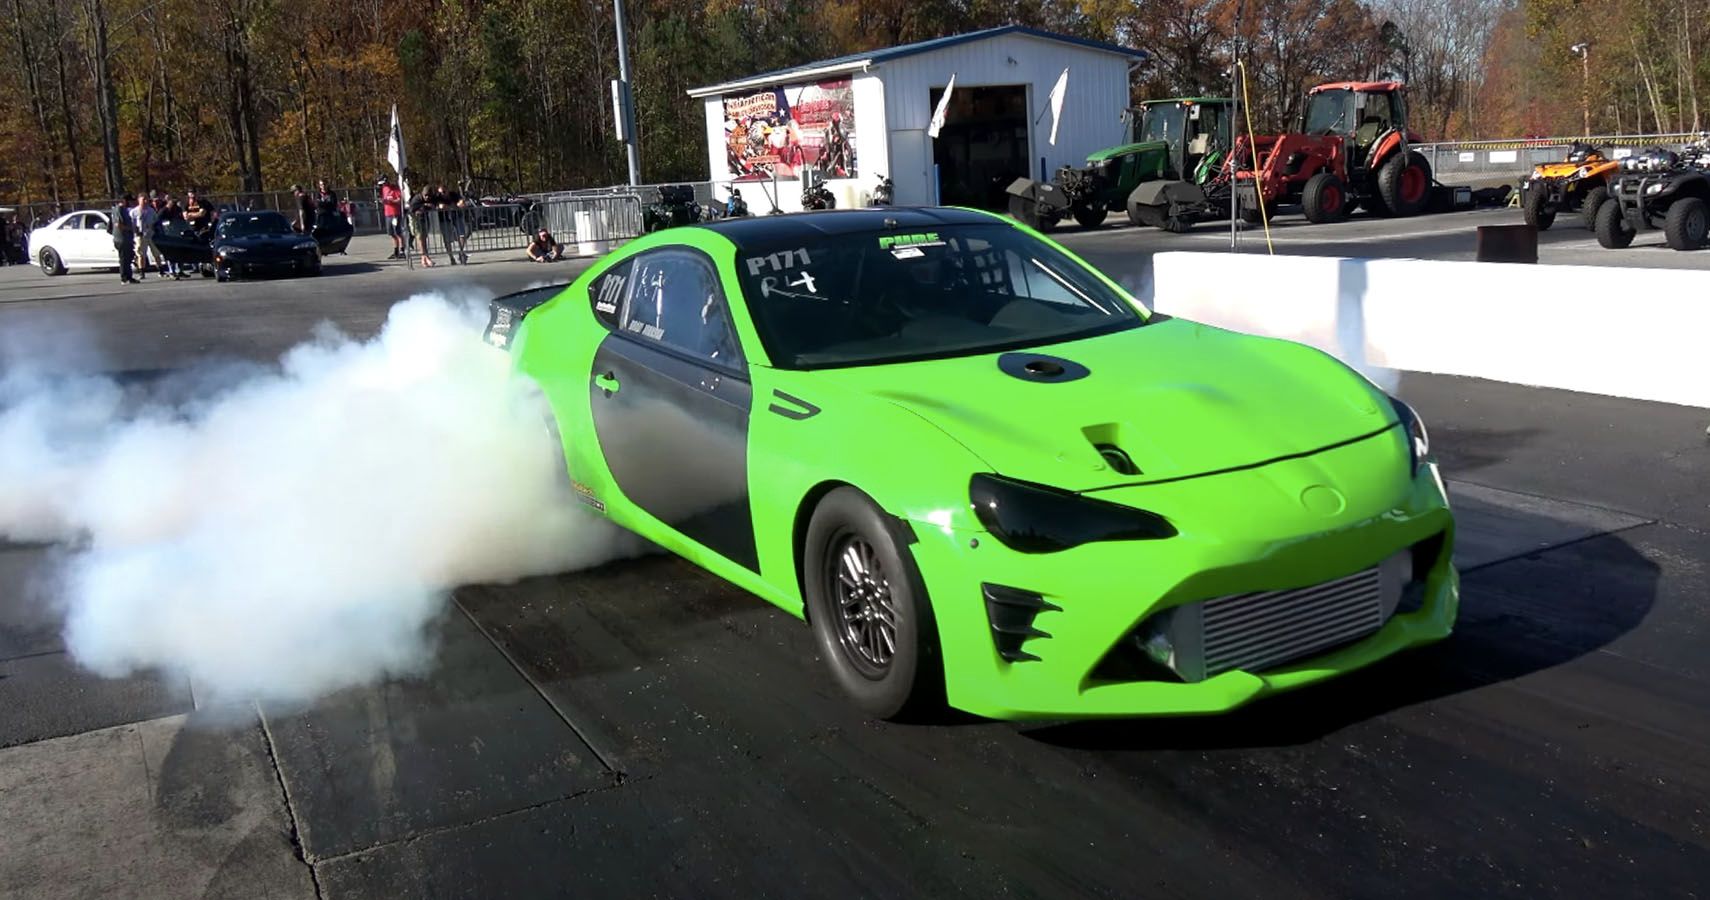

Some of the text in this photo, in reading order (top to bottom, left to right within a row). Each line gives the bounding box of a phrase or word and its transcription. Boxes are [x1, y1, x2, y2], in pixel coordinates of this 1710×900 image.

[879, 232, 939, 249] PURE
[746, 248, 811, 275] P171
[598, 273, 626, 304] P171
